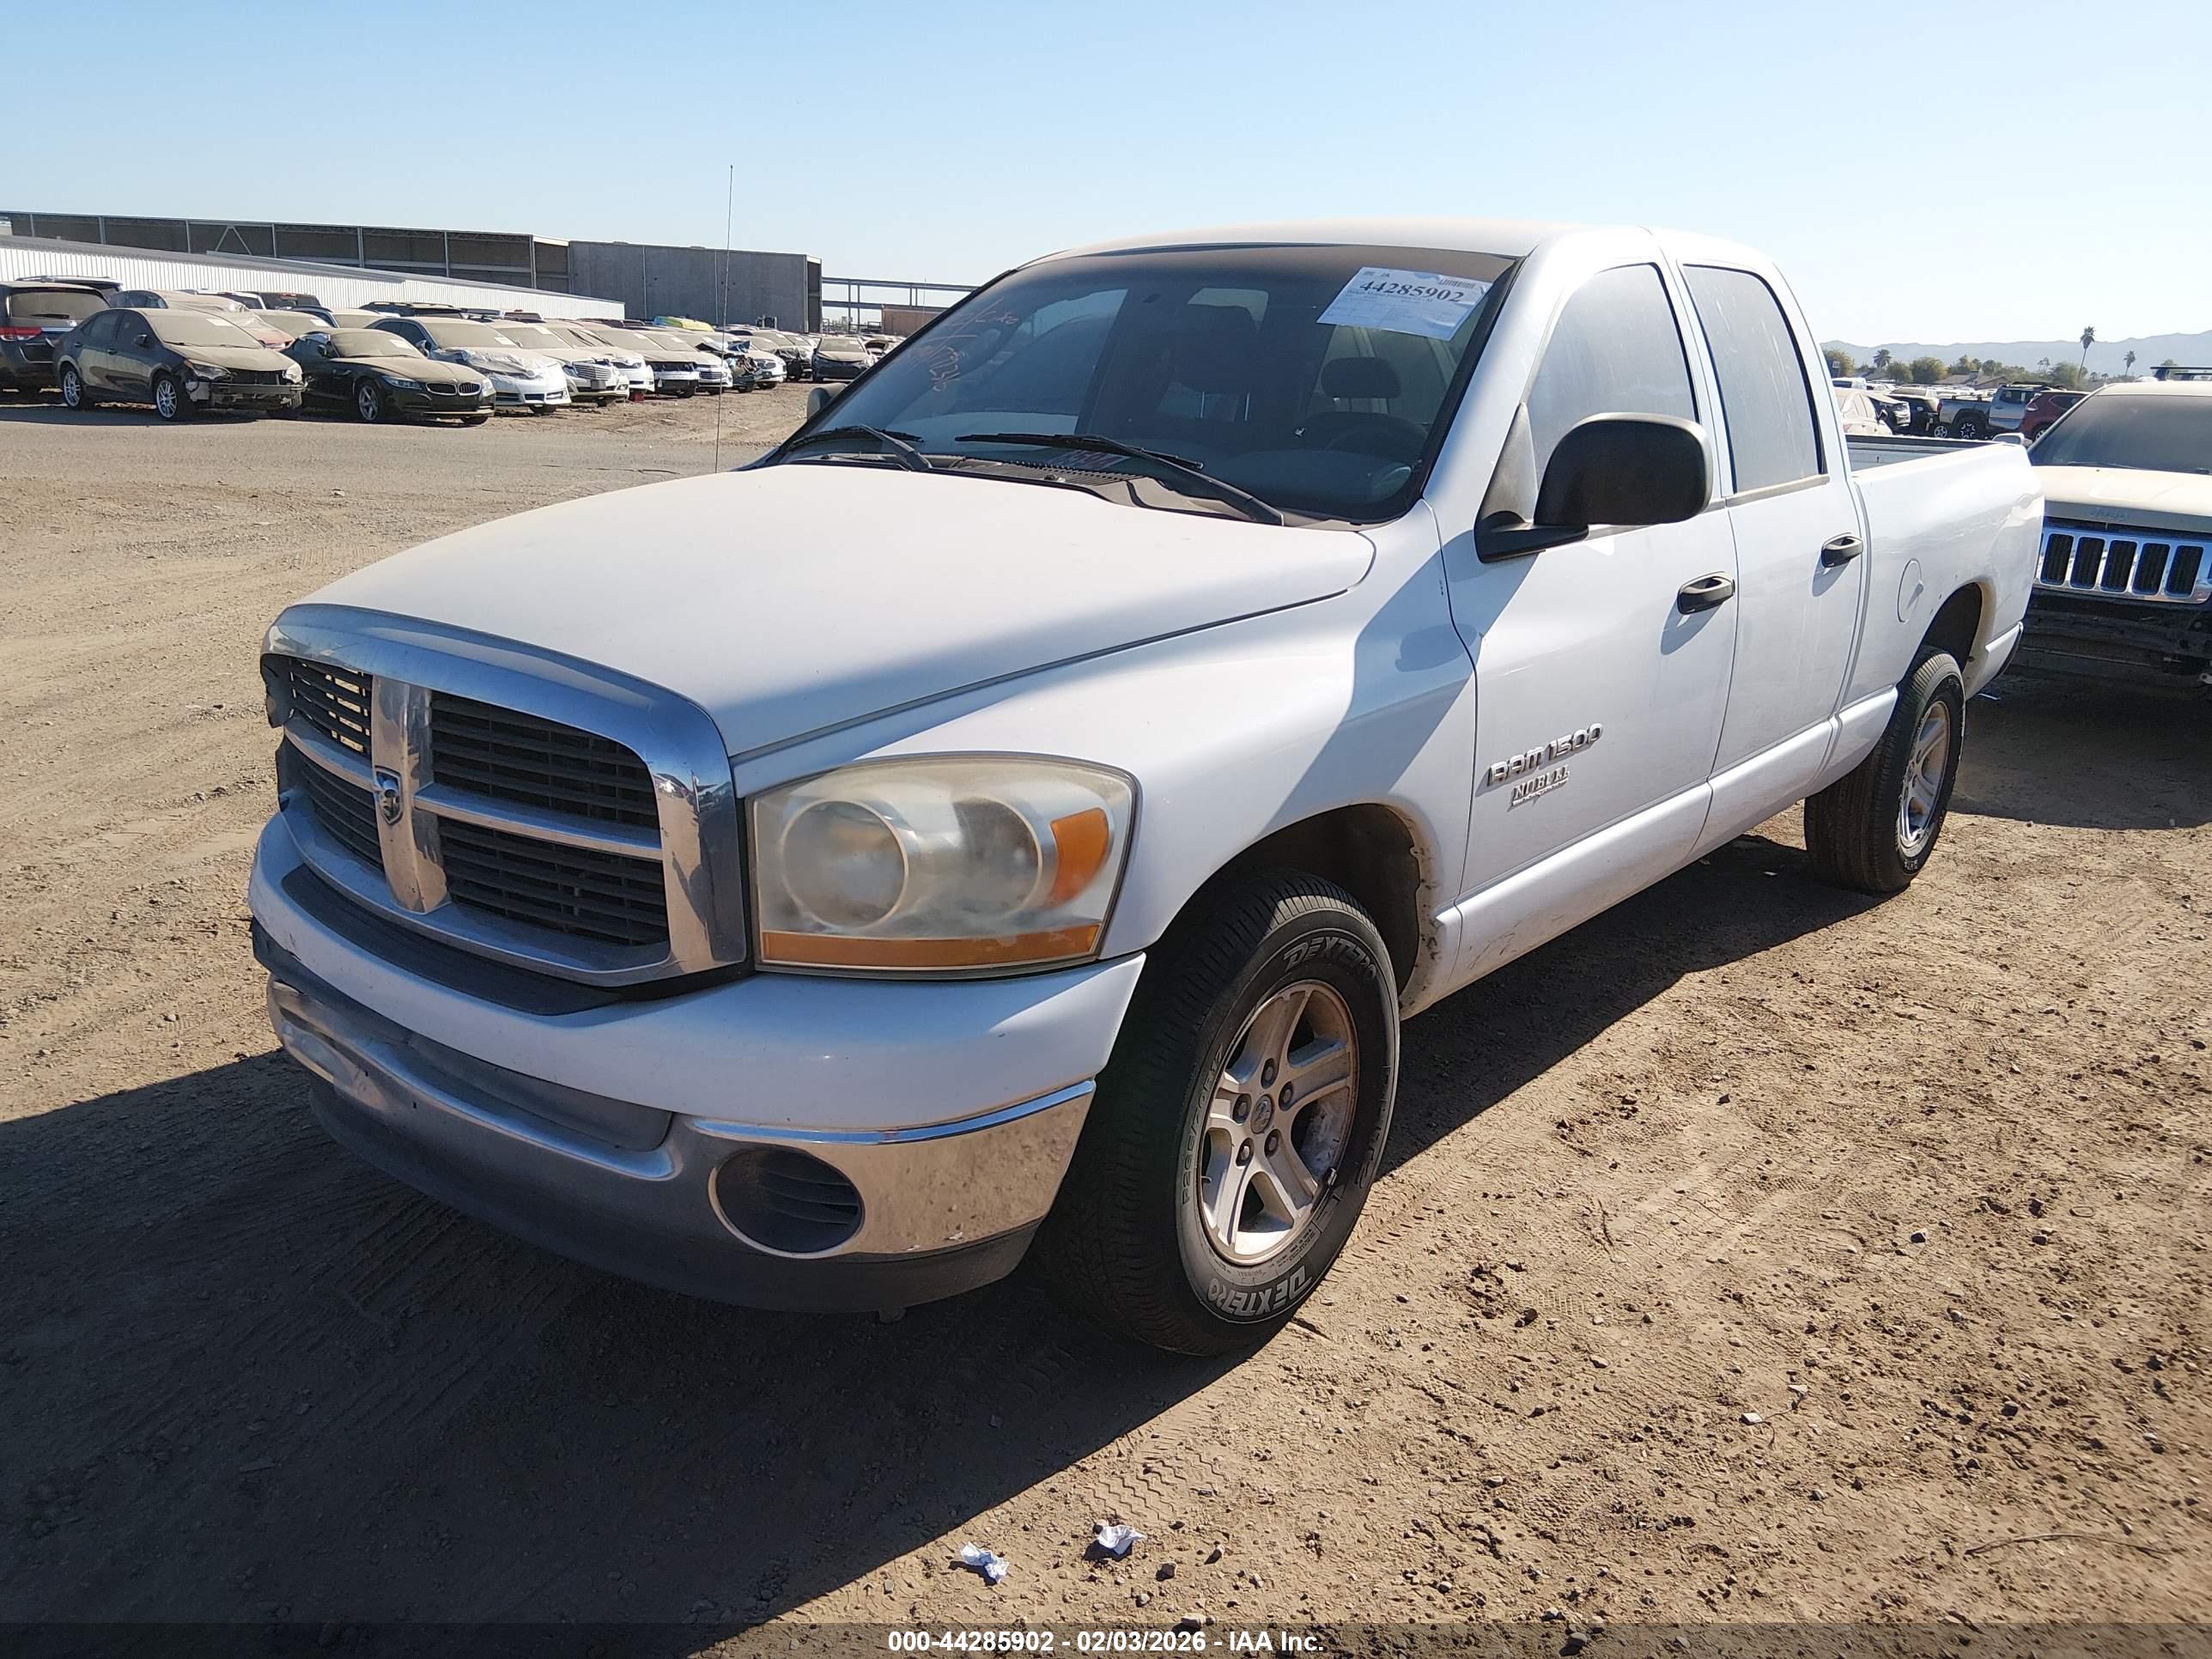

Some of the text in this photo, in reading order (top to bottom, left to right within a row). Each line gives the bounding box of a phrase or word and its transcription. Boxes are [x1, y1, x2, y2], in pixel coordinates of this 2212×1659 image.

[1359, 280, 1465, 303] 44285902
[1490, 722, 1604, 785] RAM 1500
[1283, 935, 1377, 984] DEXTERO
[1207, 1265, 1312, 1317] DEXTERO
